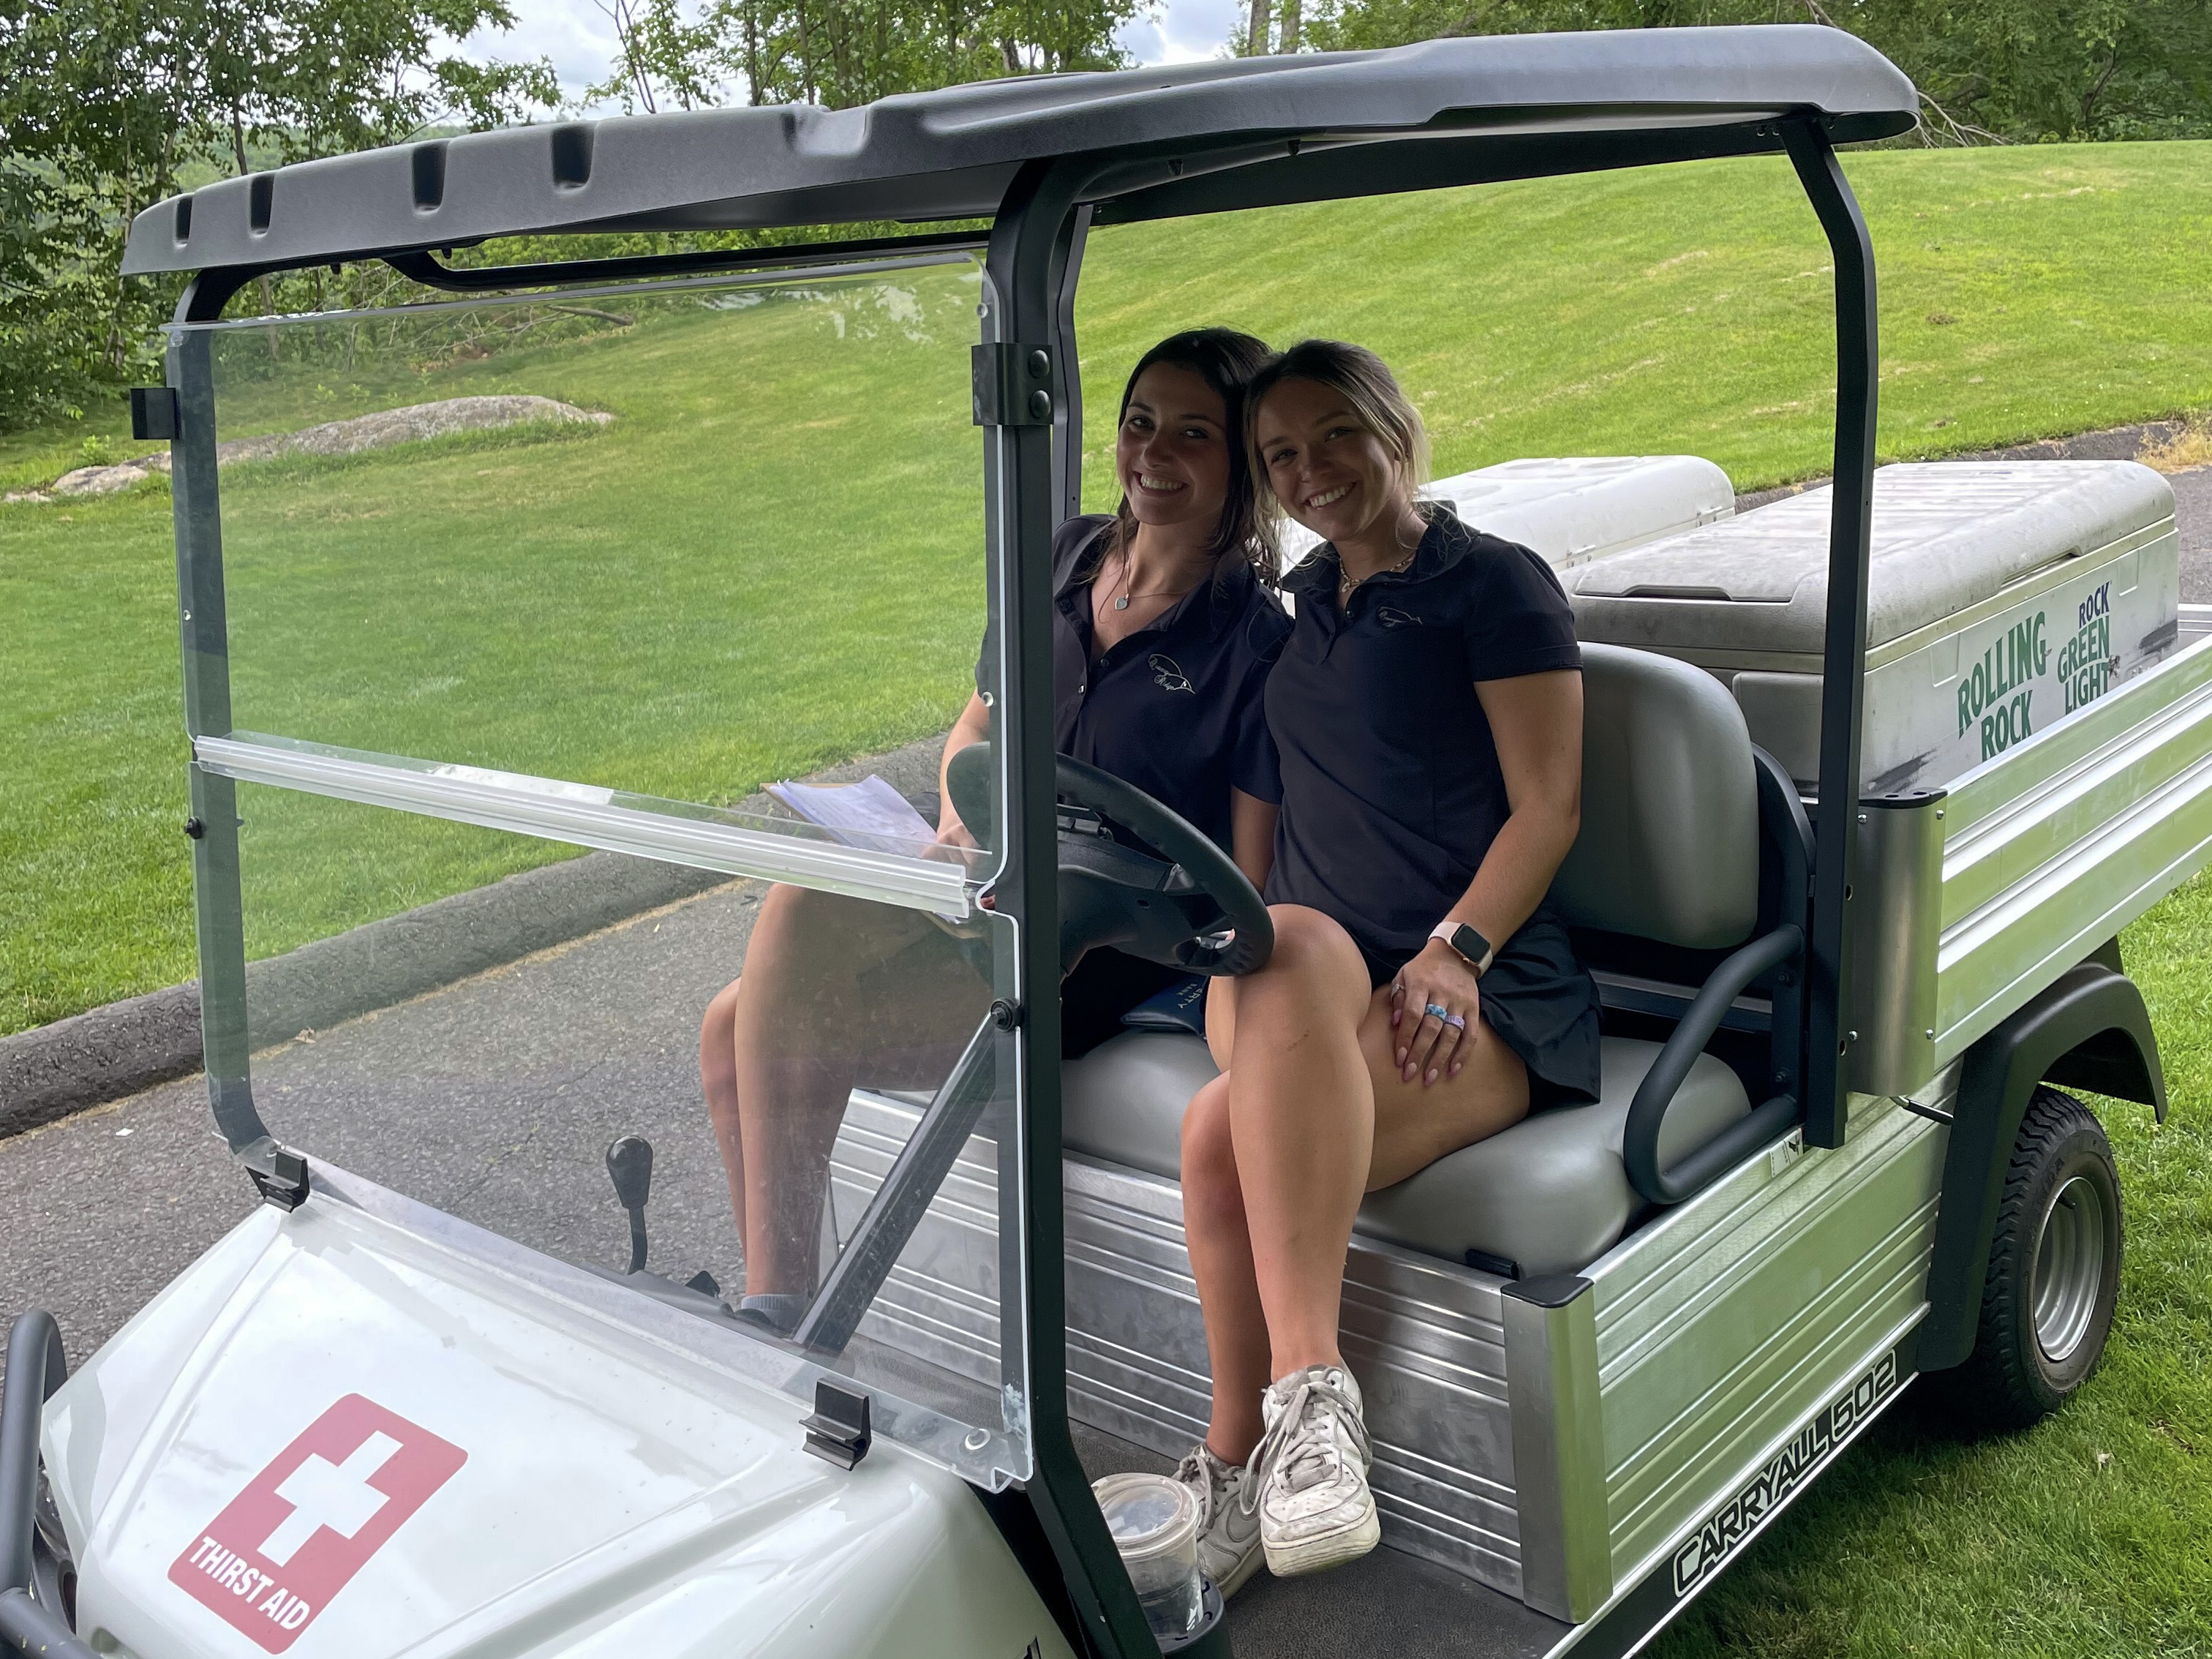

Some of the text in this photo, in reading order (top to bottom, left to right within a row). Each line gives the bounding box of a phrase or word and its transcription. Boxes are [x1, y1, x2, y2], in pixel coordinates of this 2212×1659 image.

[2079, 582, 2110, 630] ROCK
[1958, 612, 2046, 740] ROLLING
[2058, 615, 2110, 684] GREEN
[2065, 662, 2110, 715] LIGHT
[1981, 690, 2033, 762] ROCK
[1674, 1347, 1897, 1598] CARRYALL 502
[189, 1535, 310, 1630] THIRST AID
